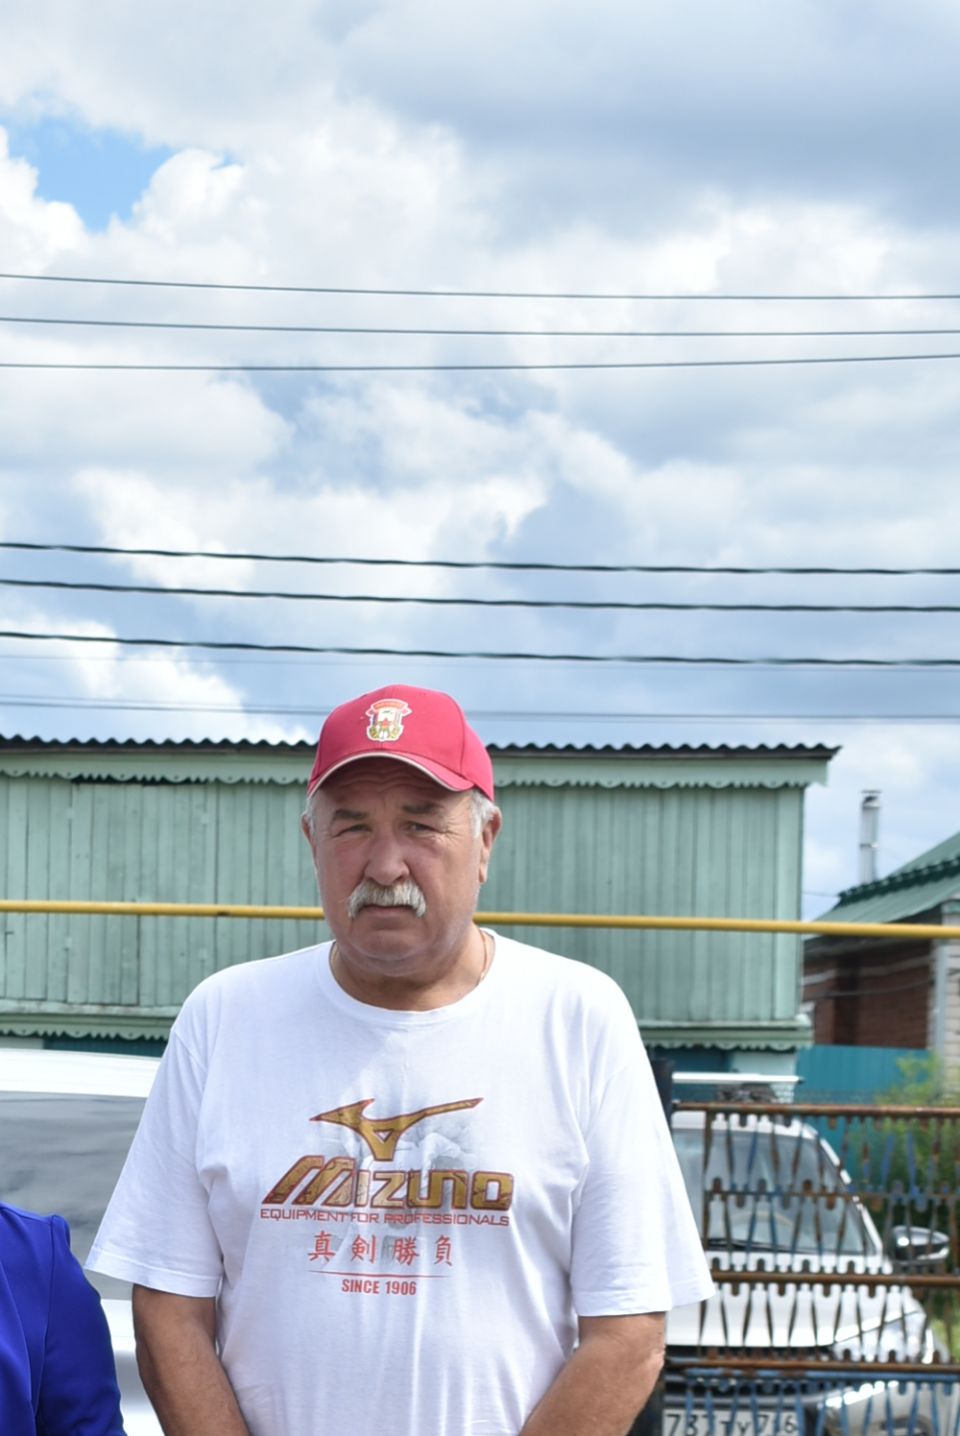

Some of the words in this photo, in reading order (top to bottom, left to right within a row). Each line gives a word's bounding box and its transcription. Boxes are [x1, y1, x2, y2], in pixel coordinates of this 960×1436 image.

[260, 1209, 349, 1224] EQUIPMENT
[351, 1211, 380, 1224] FOR
[383, 1212, 510, 1226] PROFESSIONALS
[341, 1278, 380, 1294] SINCE
[385, 1280, 416, 1295] 1906
